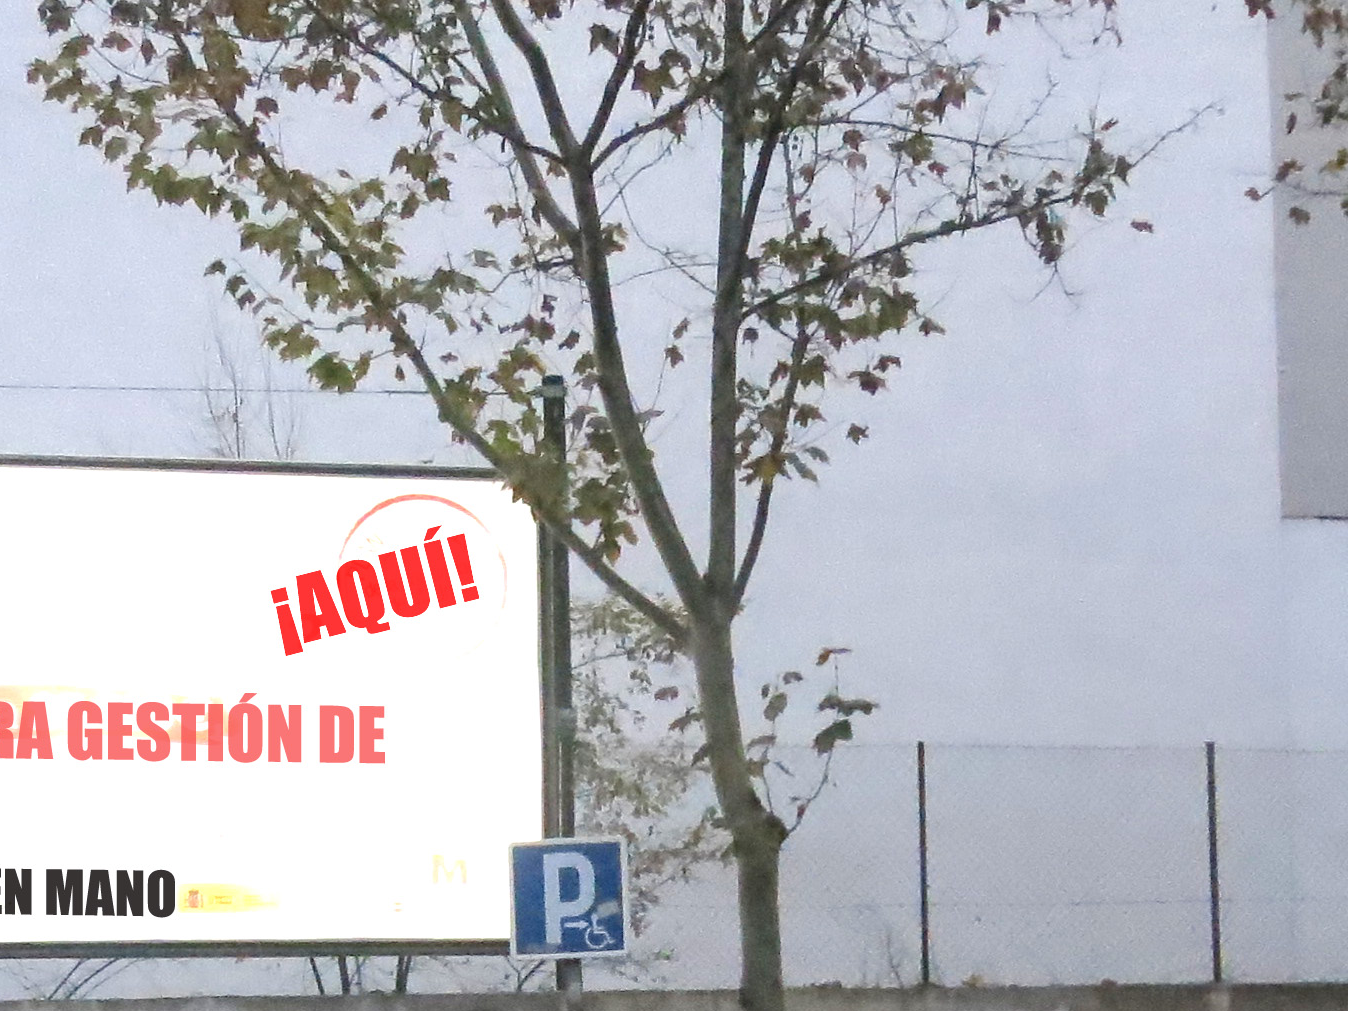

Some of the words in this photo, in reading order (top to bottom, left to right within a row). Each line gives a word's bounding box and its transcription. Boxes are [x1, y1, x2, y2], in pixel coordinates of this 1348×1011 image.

[271, 526, 479, 656] ¡AQUÍ!
[68, 693, 301, 762] GESTIÓN
[320, 706, 385, 763] DE
[46, 869, 175, 917] MANO
[543, 852, 595, 944] P
